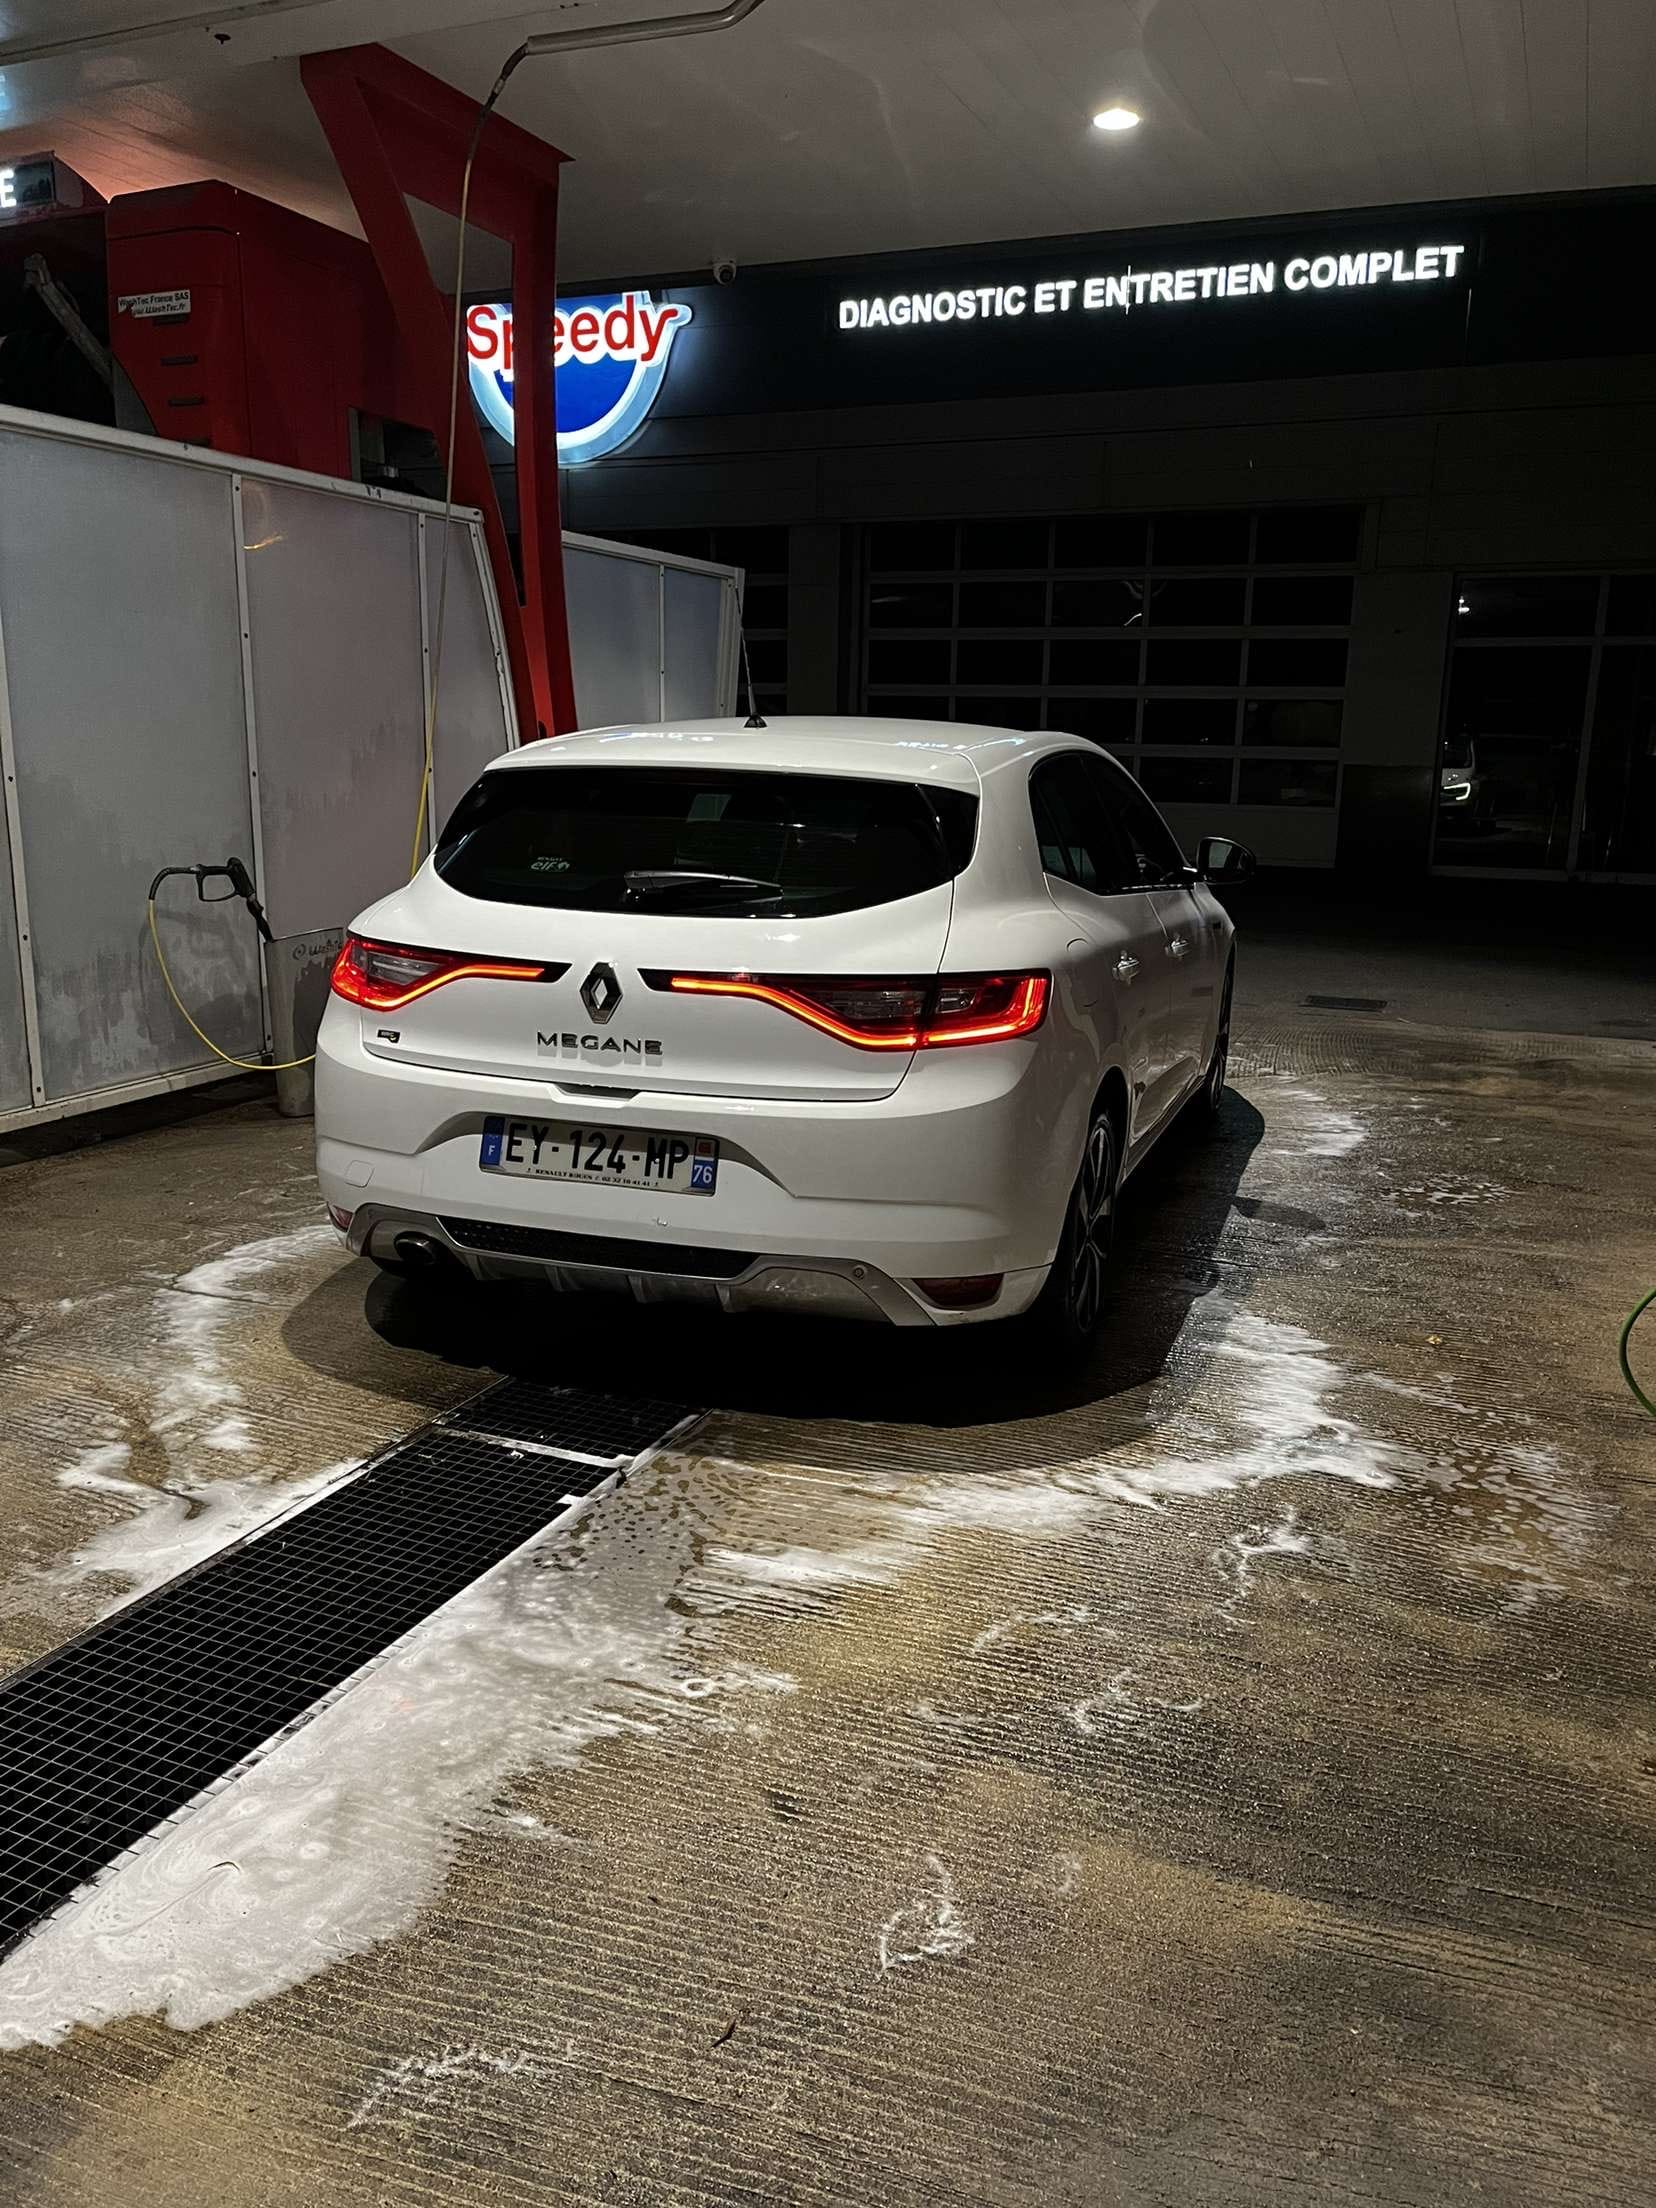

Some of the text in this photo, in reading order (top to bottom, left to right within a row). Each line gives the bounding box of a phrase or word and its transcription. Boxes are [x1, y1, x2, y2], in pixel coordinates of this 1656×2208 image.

[175, 292, 189, 301] SAS
[840, 246, 1464, 328] DIAGNOSTIC ET ENTRETIEN COMPLET
[537, 1031, 663, 1055] MEGANE
[488, 1144, 496, 1156] F
[692, 1164, 713, 1184] 76
[535, 1169, 567, 1177] RENAULT
